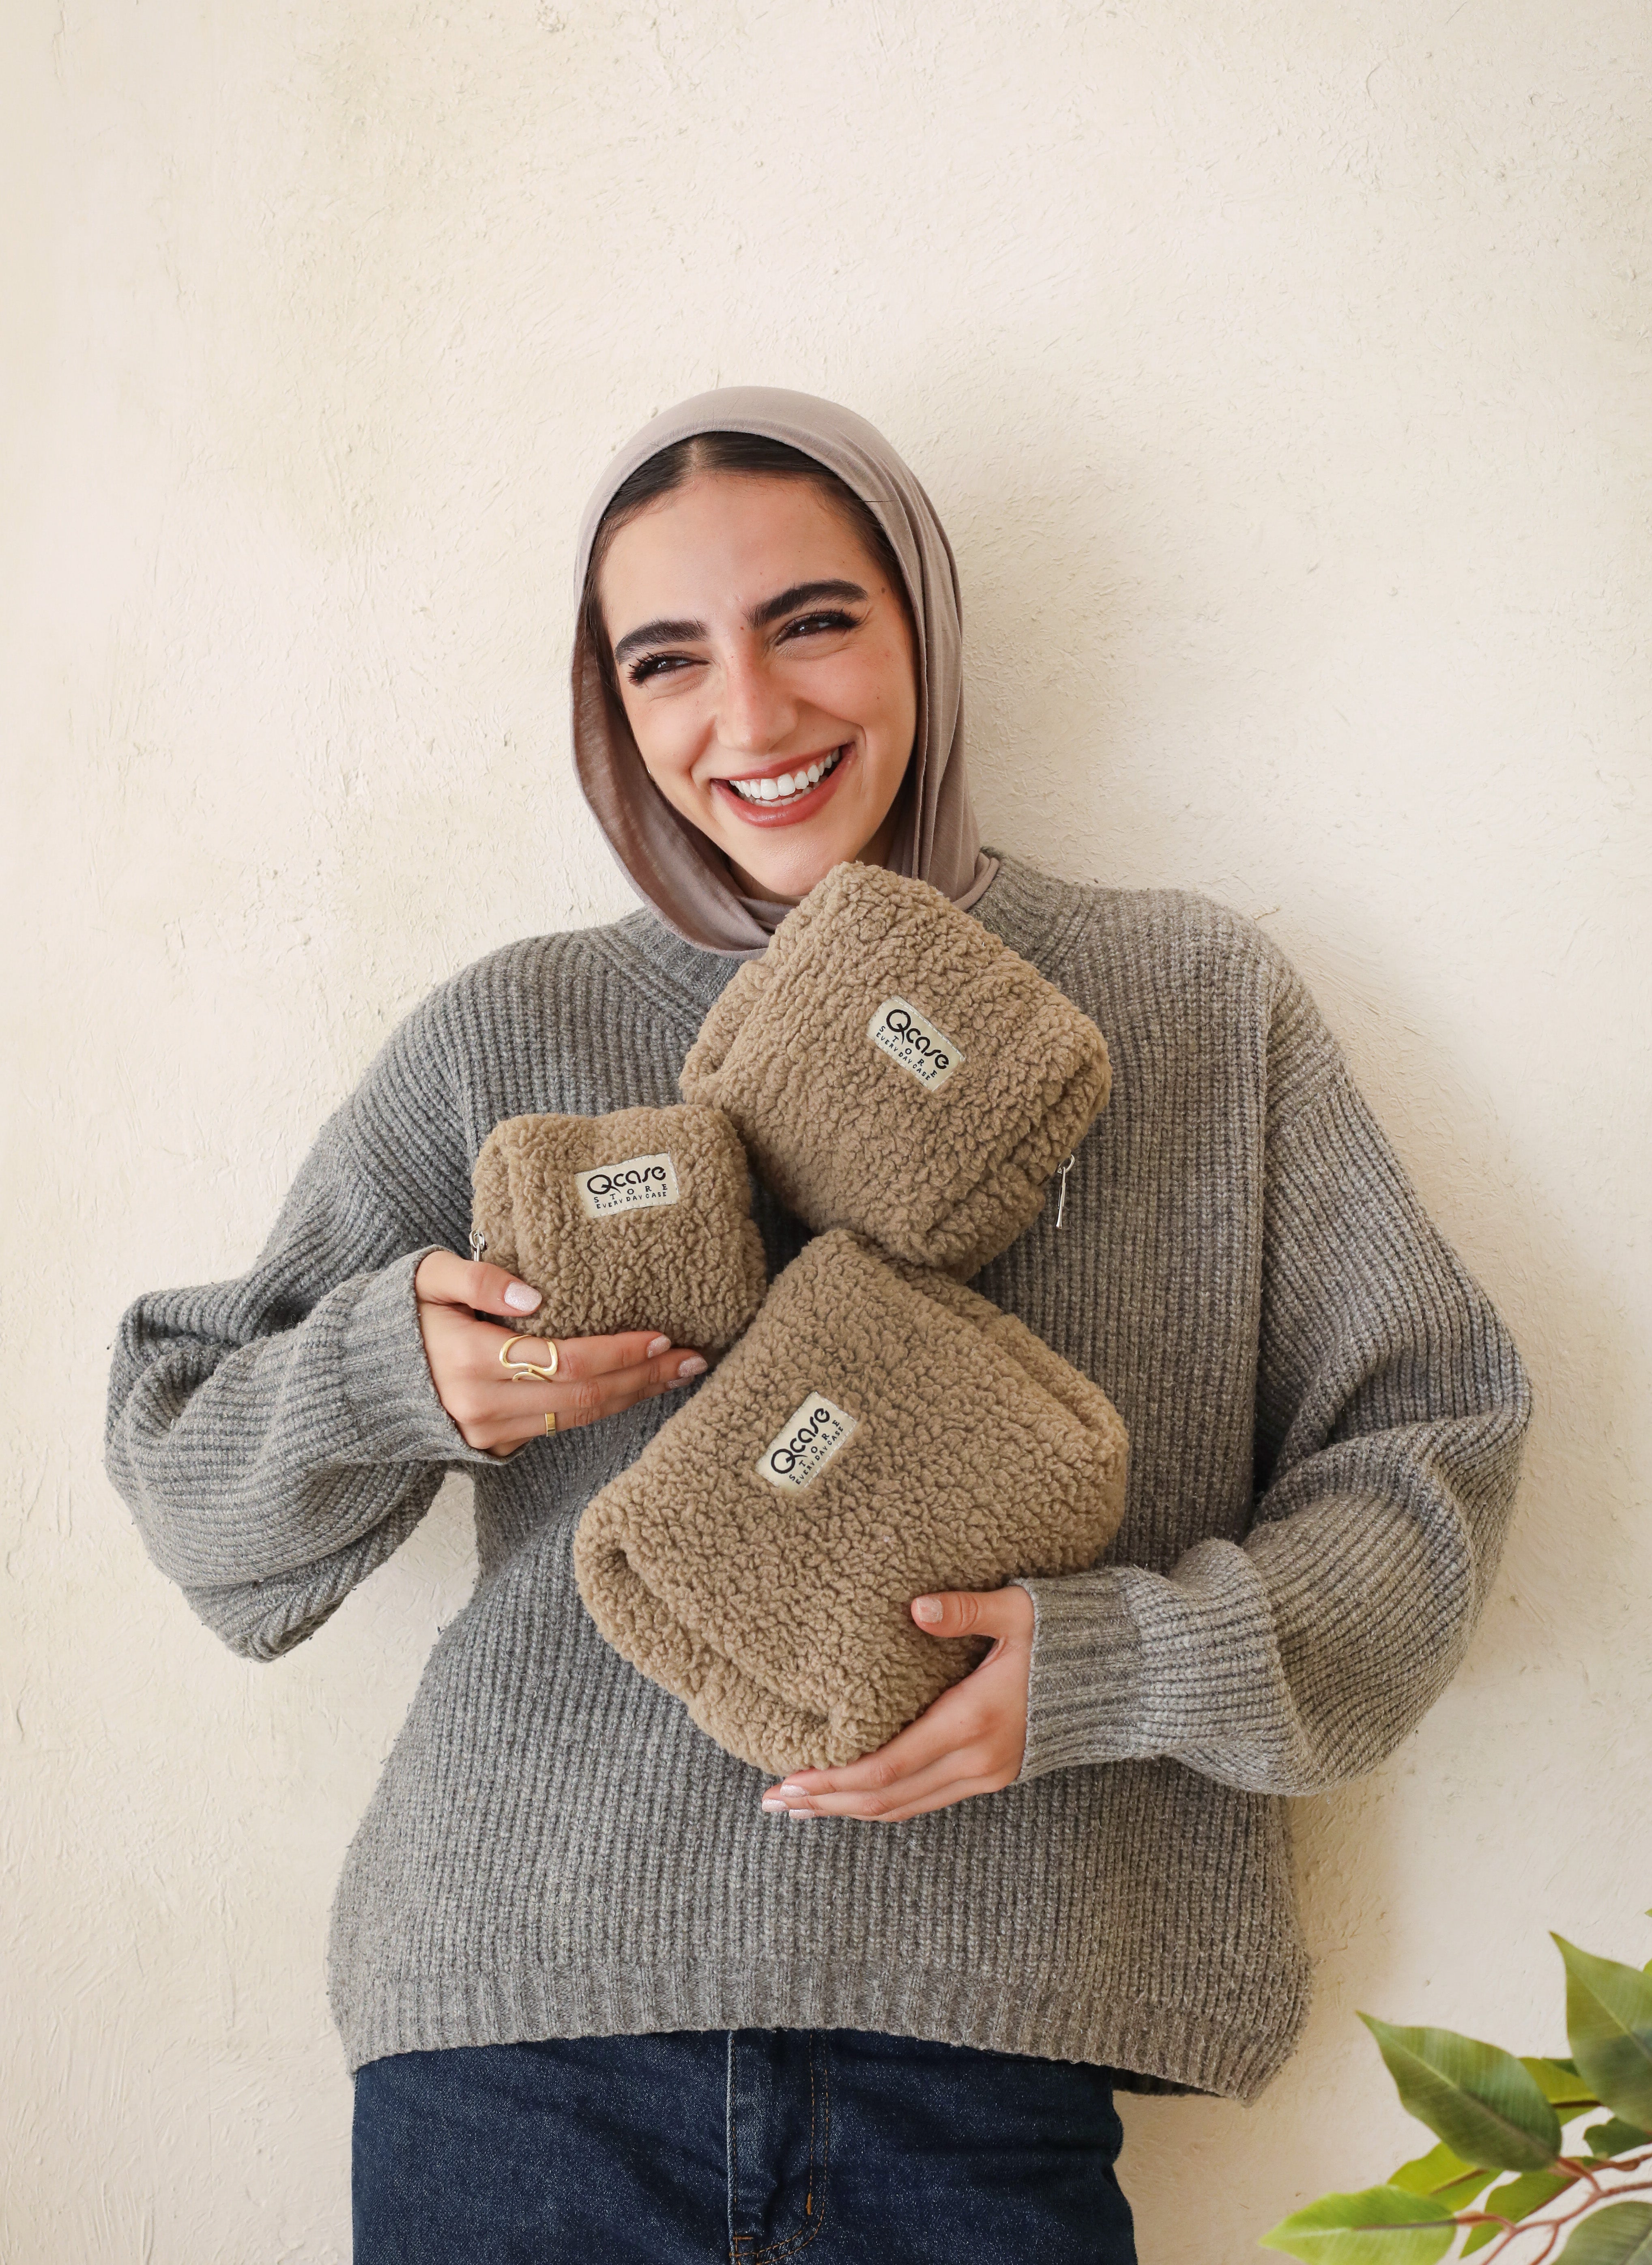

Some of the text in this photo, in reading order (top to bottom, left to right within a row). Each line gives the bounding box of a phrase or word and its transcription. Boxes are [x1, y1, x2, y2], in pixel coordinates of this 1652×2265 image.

[876, 1032, 930, 1081] EVERY DAY CASE
[880, 1026, 937, 1077] STORE
[594, 1184, 668, 1203] STORE
[597, 1199, 623, 1209] EVERY
[789, 1420, 840, 1481] STORE
[795, 1427, 844, 1485] EVERY DAY CASE
